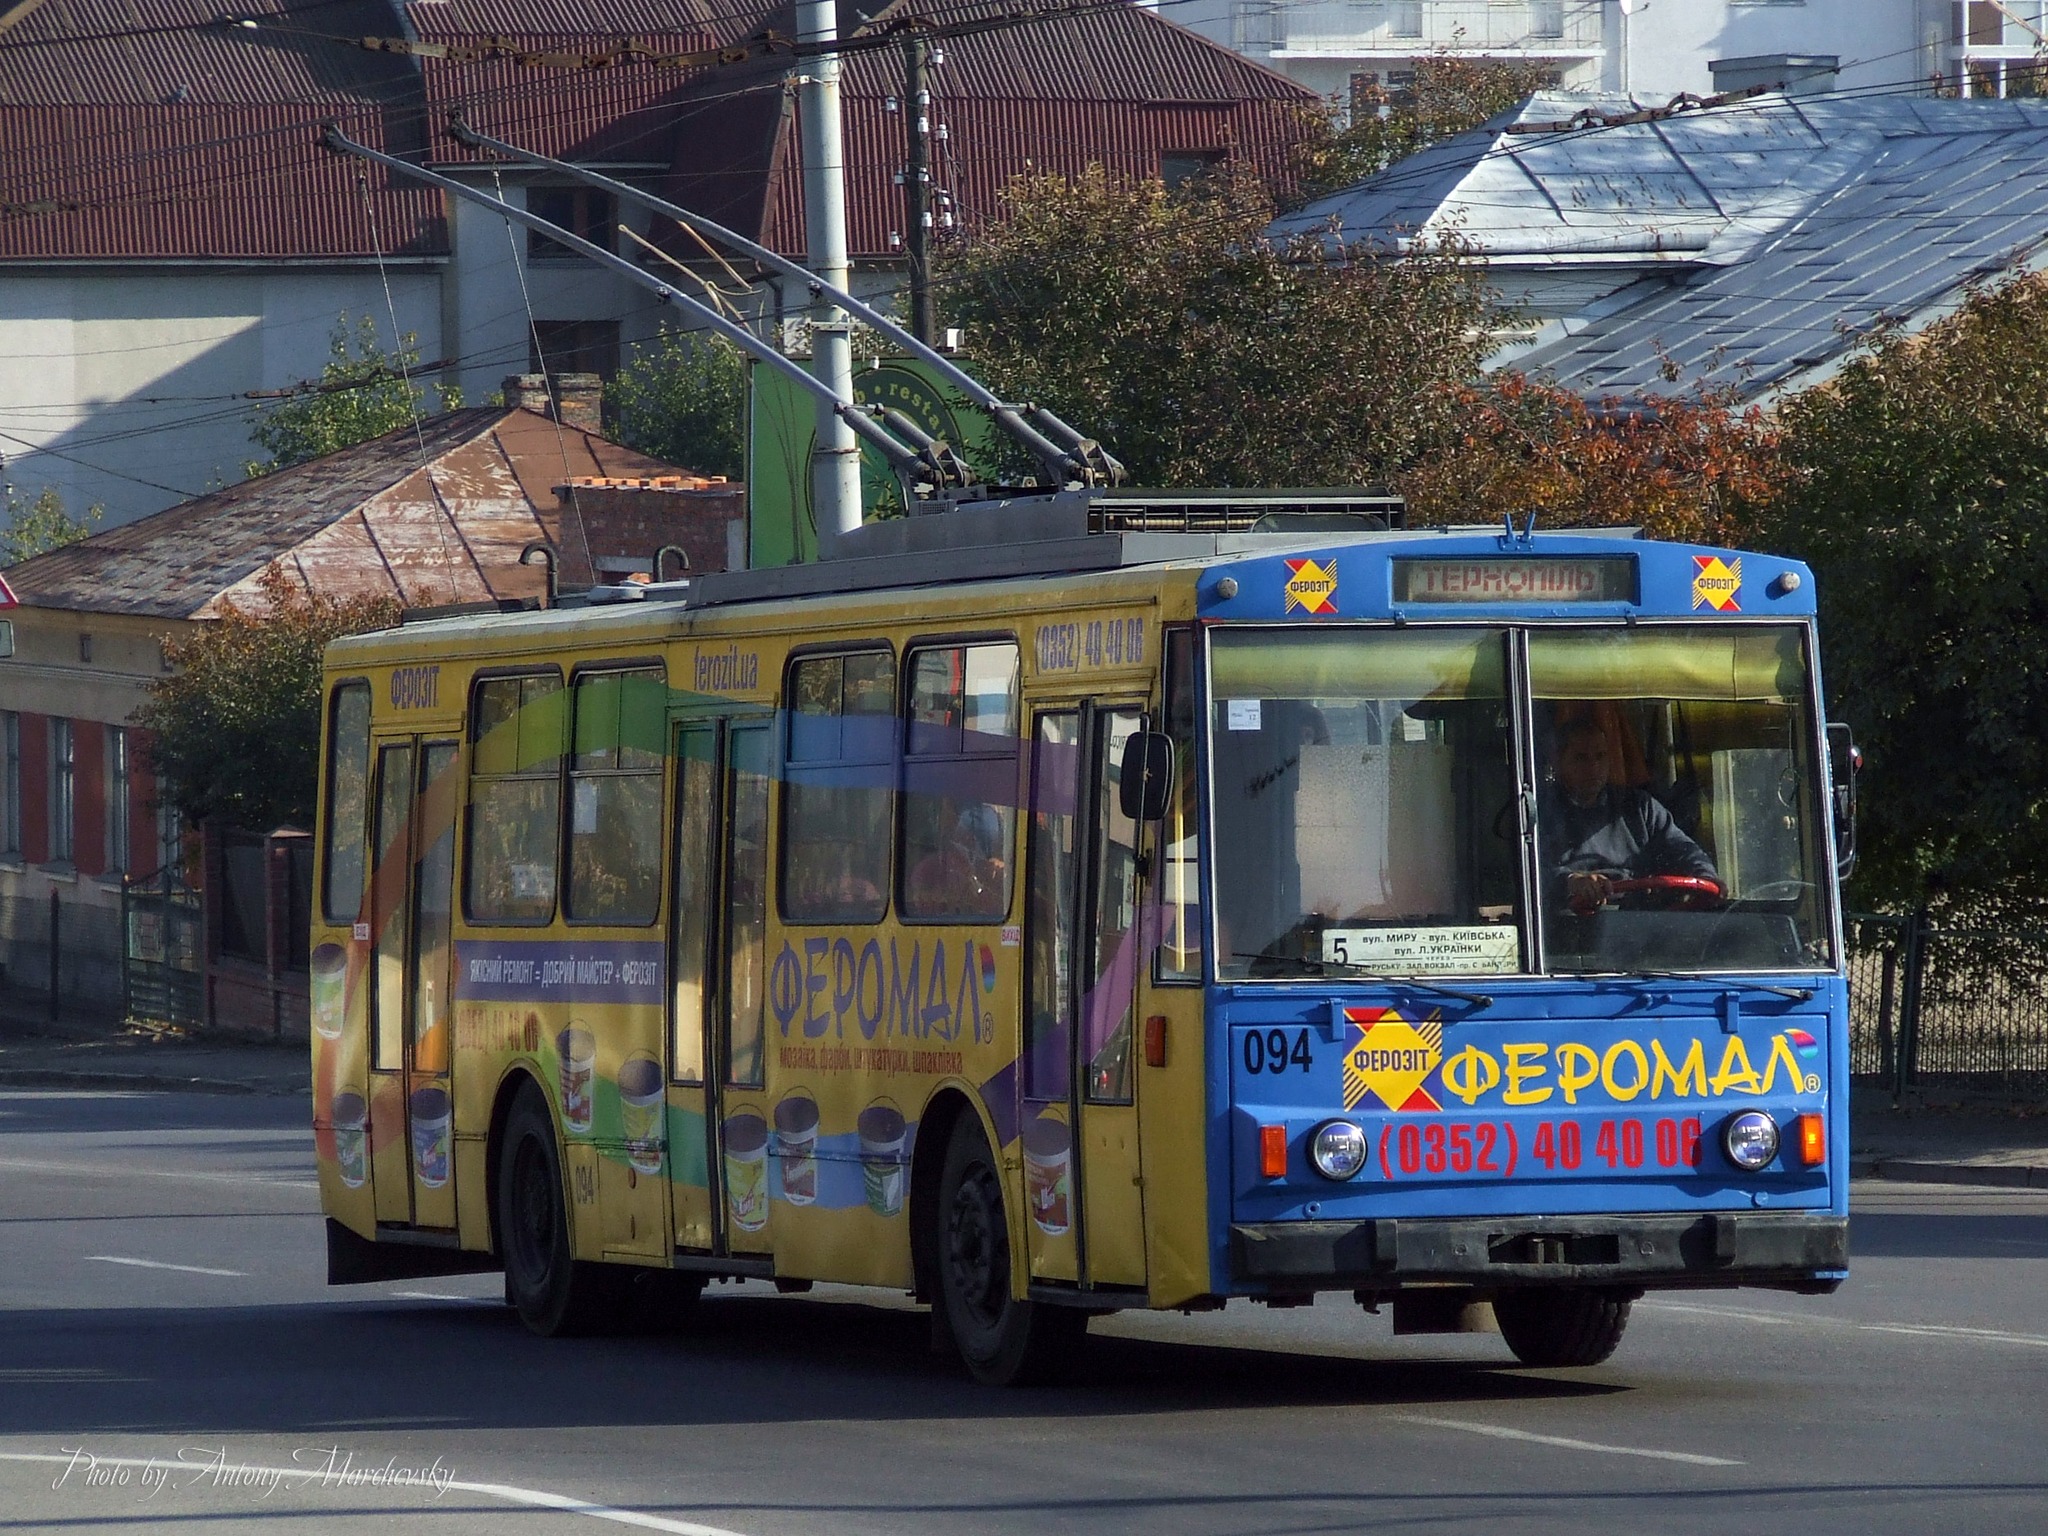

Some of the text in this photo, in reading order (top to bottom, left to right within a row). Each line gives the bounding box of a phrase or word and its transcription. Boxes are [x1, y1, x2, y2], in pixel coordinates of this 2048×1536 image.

[1290, 580, 1331, 594] ФЕРОЗІТ
[1422, 565, 1596, 593] ТЕРНОПІЛЬ
[1698, 577, 1735, 590] ФЕРОЗІТ
[1035, 617, 1143, 676] (0352) 40 40 06
[694, 644, 758, 691] ferozit.ua
[391, 665, 440, 710] ФЕРОЗІТ
[1333, 938, 1349, 965] 5
[1363, 936, 1384, 944] вул.
[1386, 934, 1417, 942] МИРУ
[1429, 934, 1450, 943] вул.
[1453, 931, 1505, 941] КИЇВСЬКА
[1395, 948, 1415, 956] вул.
[470, 955, 501, 983] ЯКІСНИЙ
[503, 960, 534, 984] РЕМОНТ
[541, 955, 575, 988] ДОБРИЙ
[577, 956, 613, 985] МАЙСТЕР
[622, 961, 657, 986] ФЕРОЗІТ
[770, 936, 981, 1045] ФЕРОМАЛ
[1244, 1029, 1313, 1075] 094
[1354, 1049, 1430, 1072] ФЕРОЗІТ
[1441, 1034, 1805, 1105] ФЕРОМАЛ
[1378, 1118, 1701, 1180] (0352) 40 40 06
[576, 1165, 594, 1204] 094
